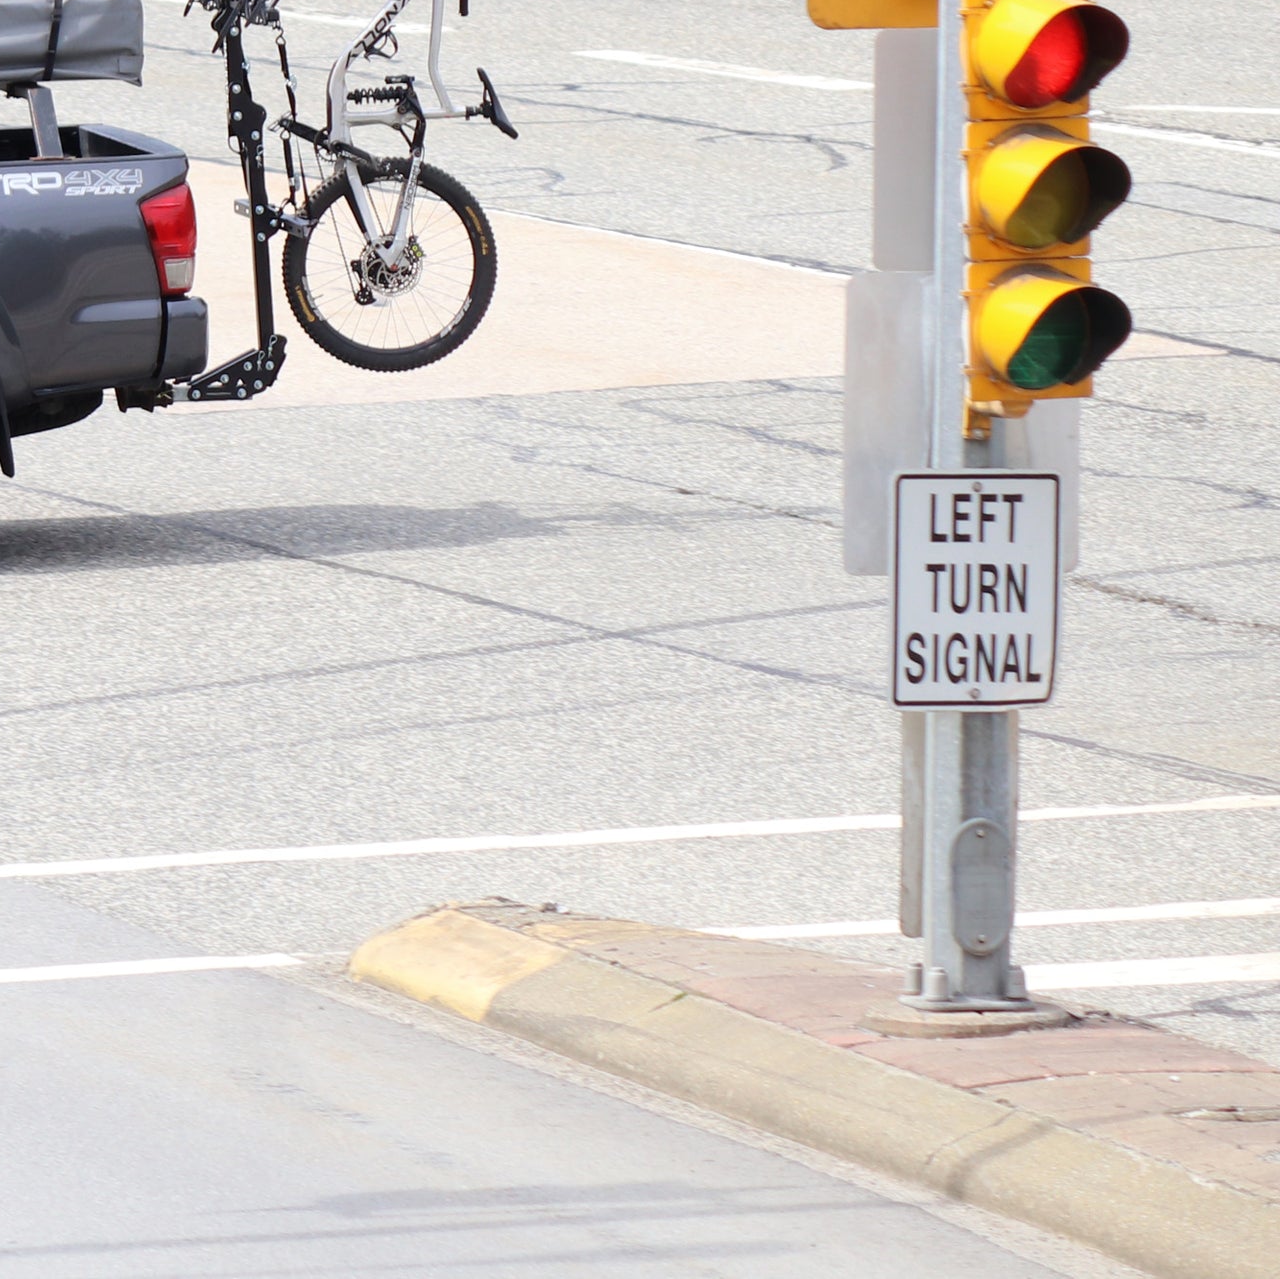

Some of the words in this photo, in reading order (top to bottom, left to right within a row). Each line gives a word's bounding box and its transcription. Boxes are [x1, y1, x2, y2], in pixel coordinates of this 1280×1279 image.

[64, 184, 143, 196] SPORT
[930, 493, 1023, 543] LEFT
[926, 564, 1028, 614] TURN
[905, 632, 1042, 684] SIGNAL
